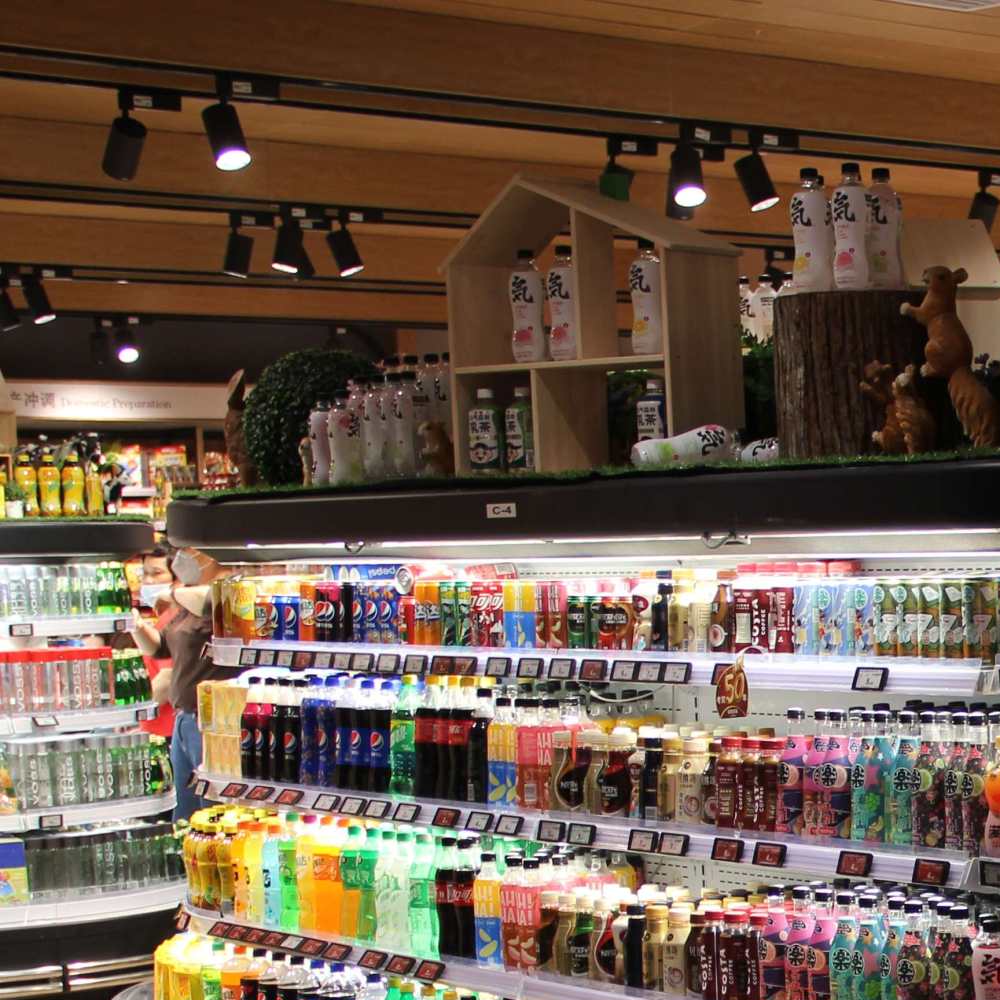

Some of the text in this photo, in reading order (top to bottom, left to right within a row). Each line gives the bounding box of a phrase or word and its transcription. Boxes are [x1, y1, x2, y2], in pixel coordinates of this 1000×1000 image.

[752, 598, 761, 646] COSTA
[725, 672, 745, 703] 50
[720, 948, 728, 995] COSTA
